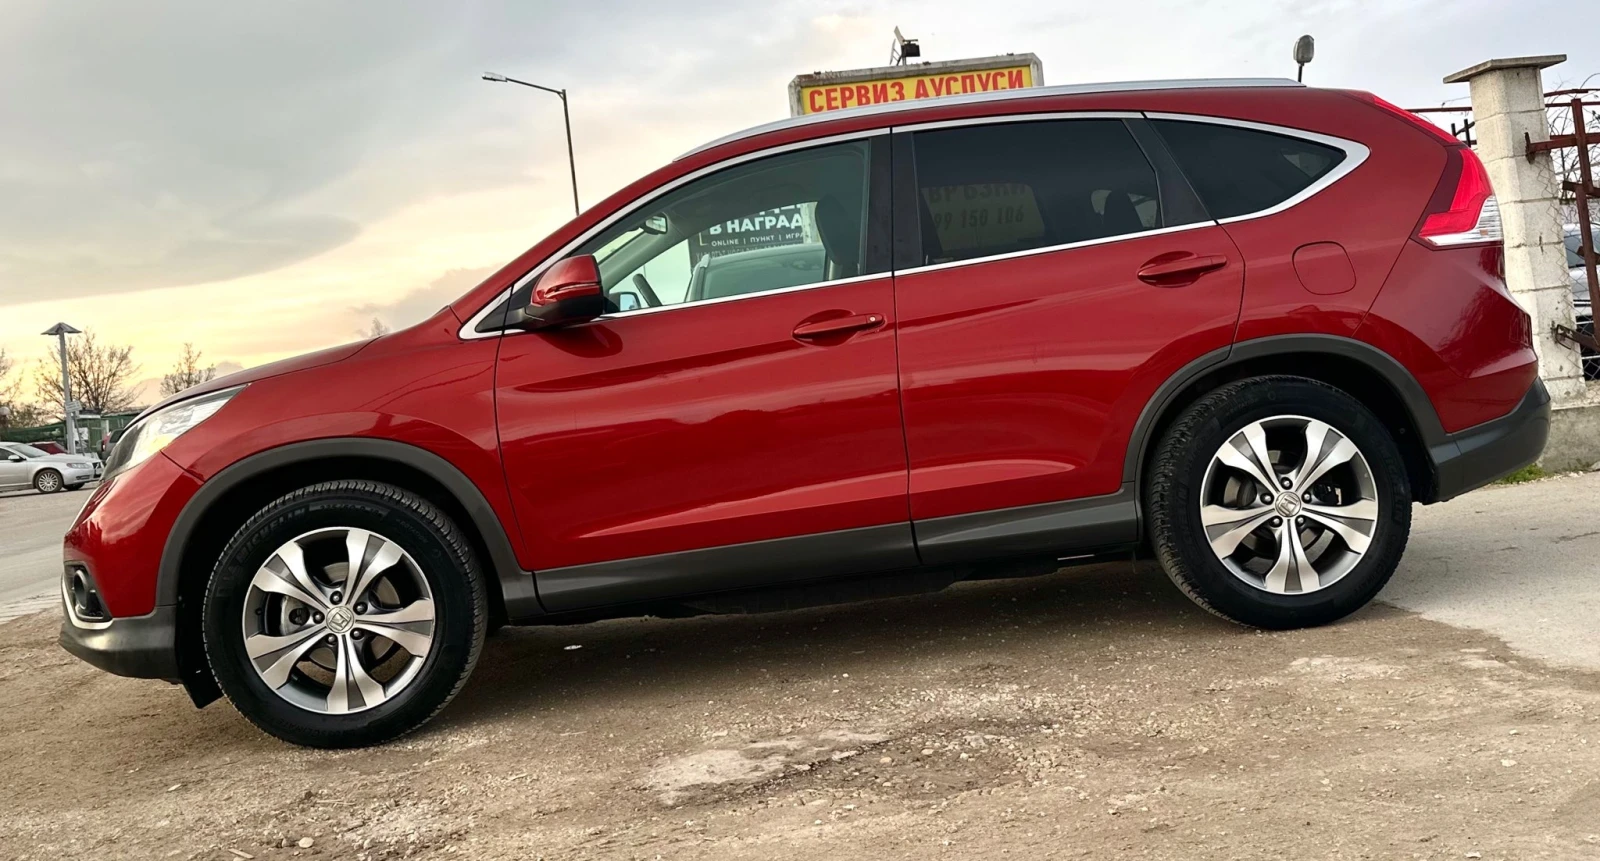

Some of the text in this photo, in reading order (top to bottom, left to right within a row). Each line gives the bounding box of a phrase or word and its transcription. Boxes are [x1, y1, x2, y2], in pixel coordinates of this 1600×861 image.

[809, 69, 1024, 113] СЕРВИЗ АУСПУСИ
[960, 208, 988, 228] 150
[711, 238, 739, 247] ONLINE
[750, 235, 775, 243] ПУНКТ
